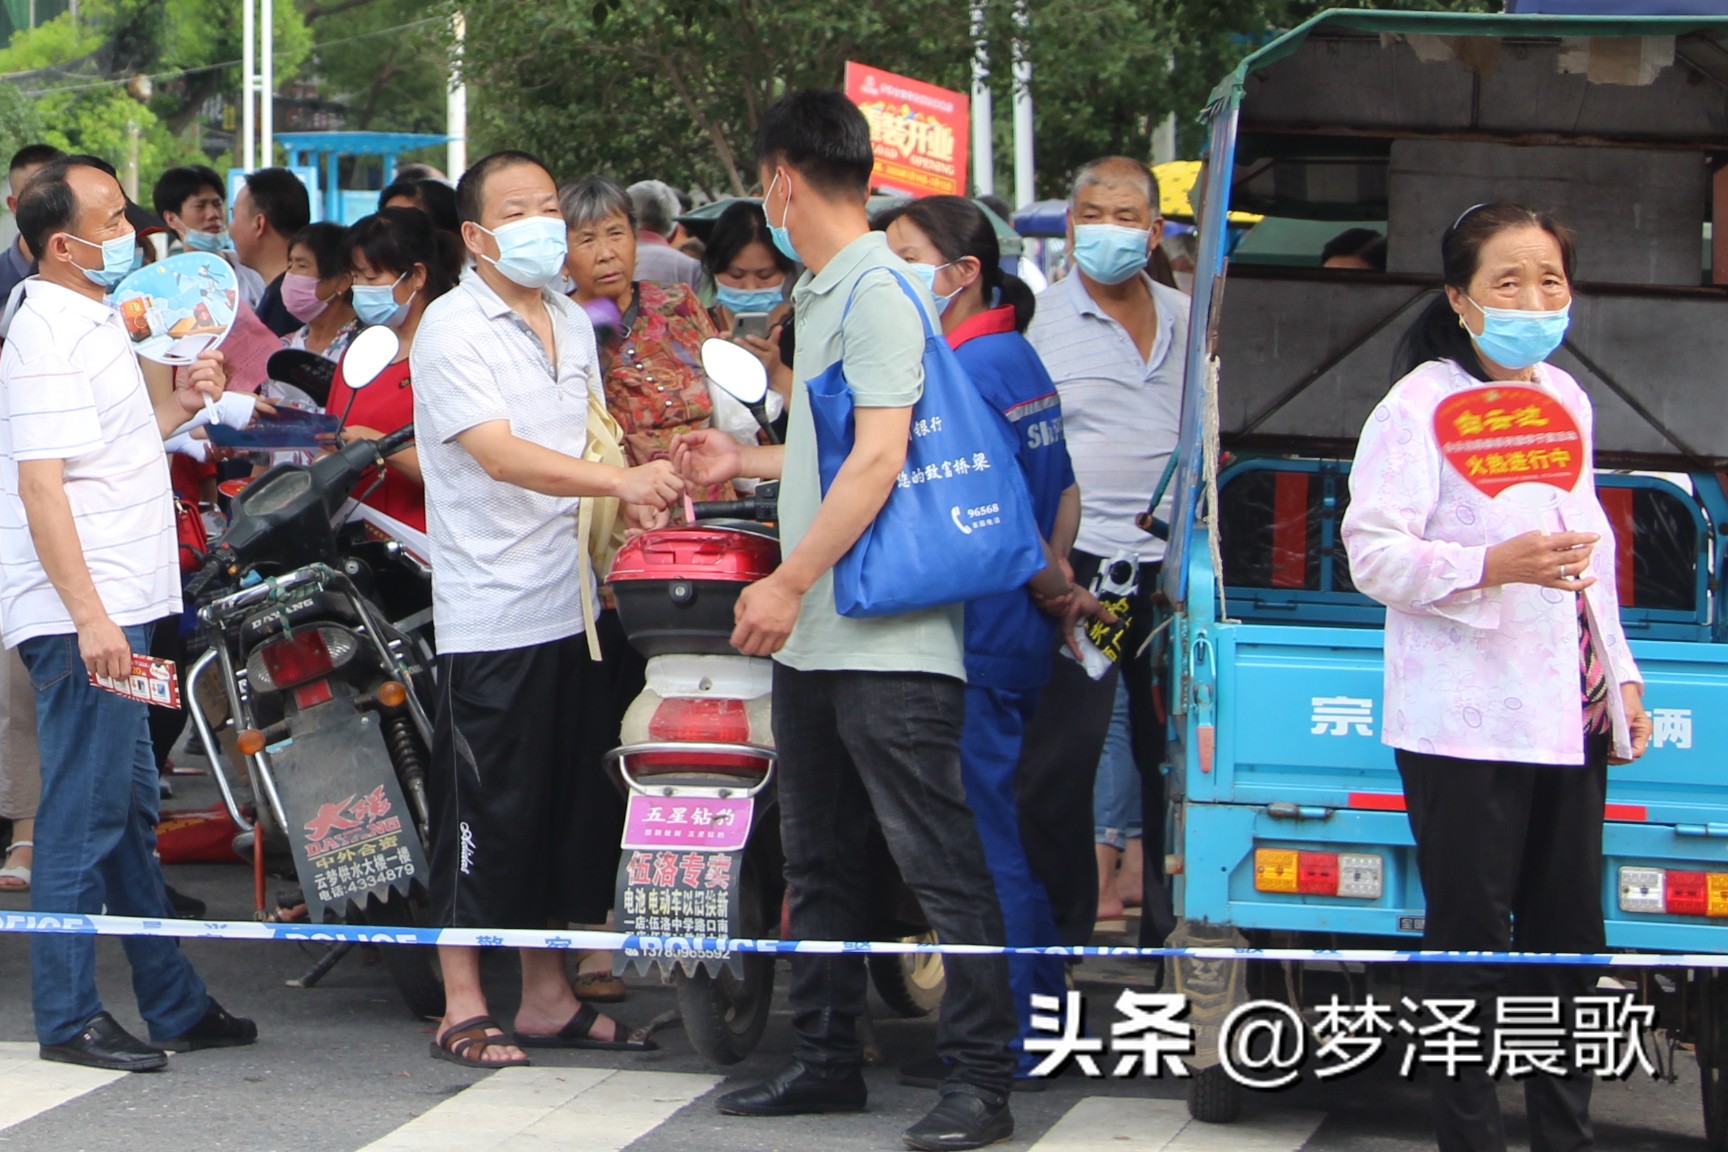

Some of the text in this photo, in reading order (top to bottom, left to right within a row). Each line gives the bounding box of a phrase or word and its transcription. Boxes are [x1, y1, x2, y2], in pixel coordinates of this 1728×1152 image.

[909, 155, 954, 175] OPENING
[909, 415, 943, 440] 银行
[1465, 447, 1571, 476] 火热进行中
[967, 503, 1000, 518] 96568
[641, 806, 735, 827] 五星钻豹
[315, 835, 398, 869] 中外合资
[314, 846, 411, 890] 云梦供水大楼一楼
[626, 851, 732, 890] 伍洛专卖
[318, 863, 415, 902] 电话:4334879
[623, 887, 646, 915] 电池
